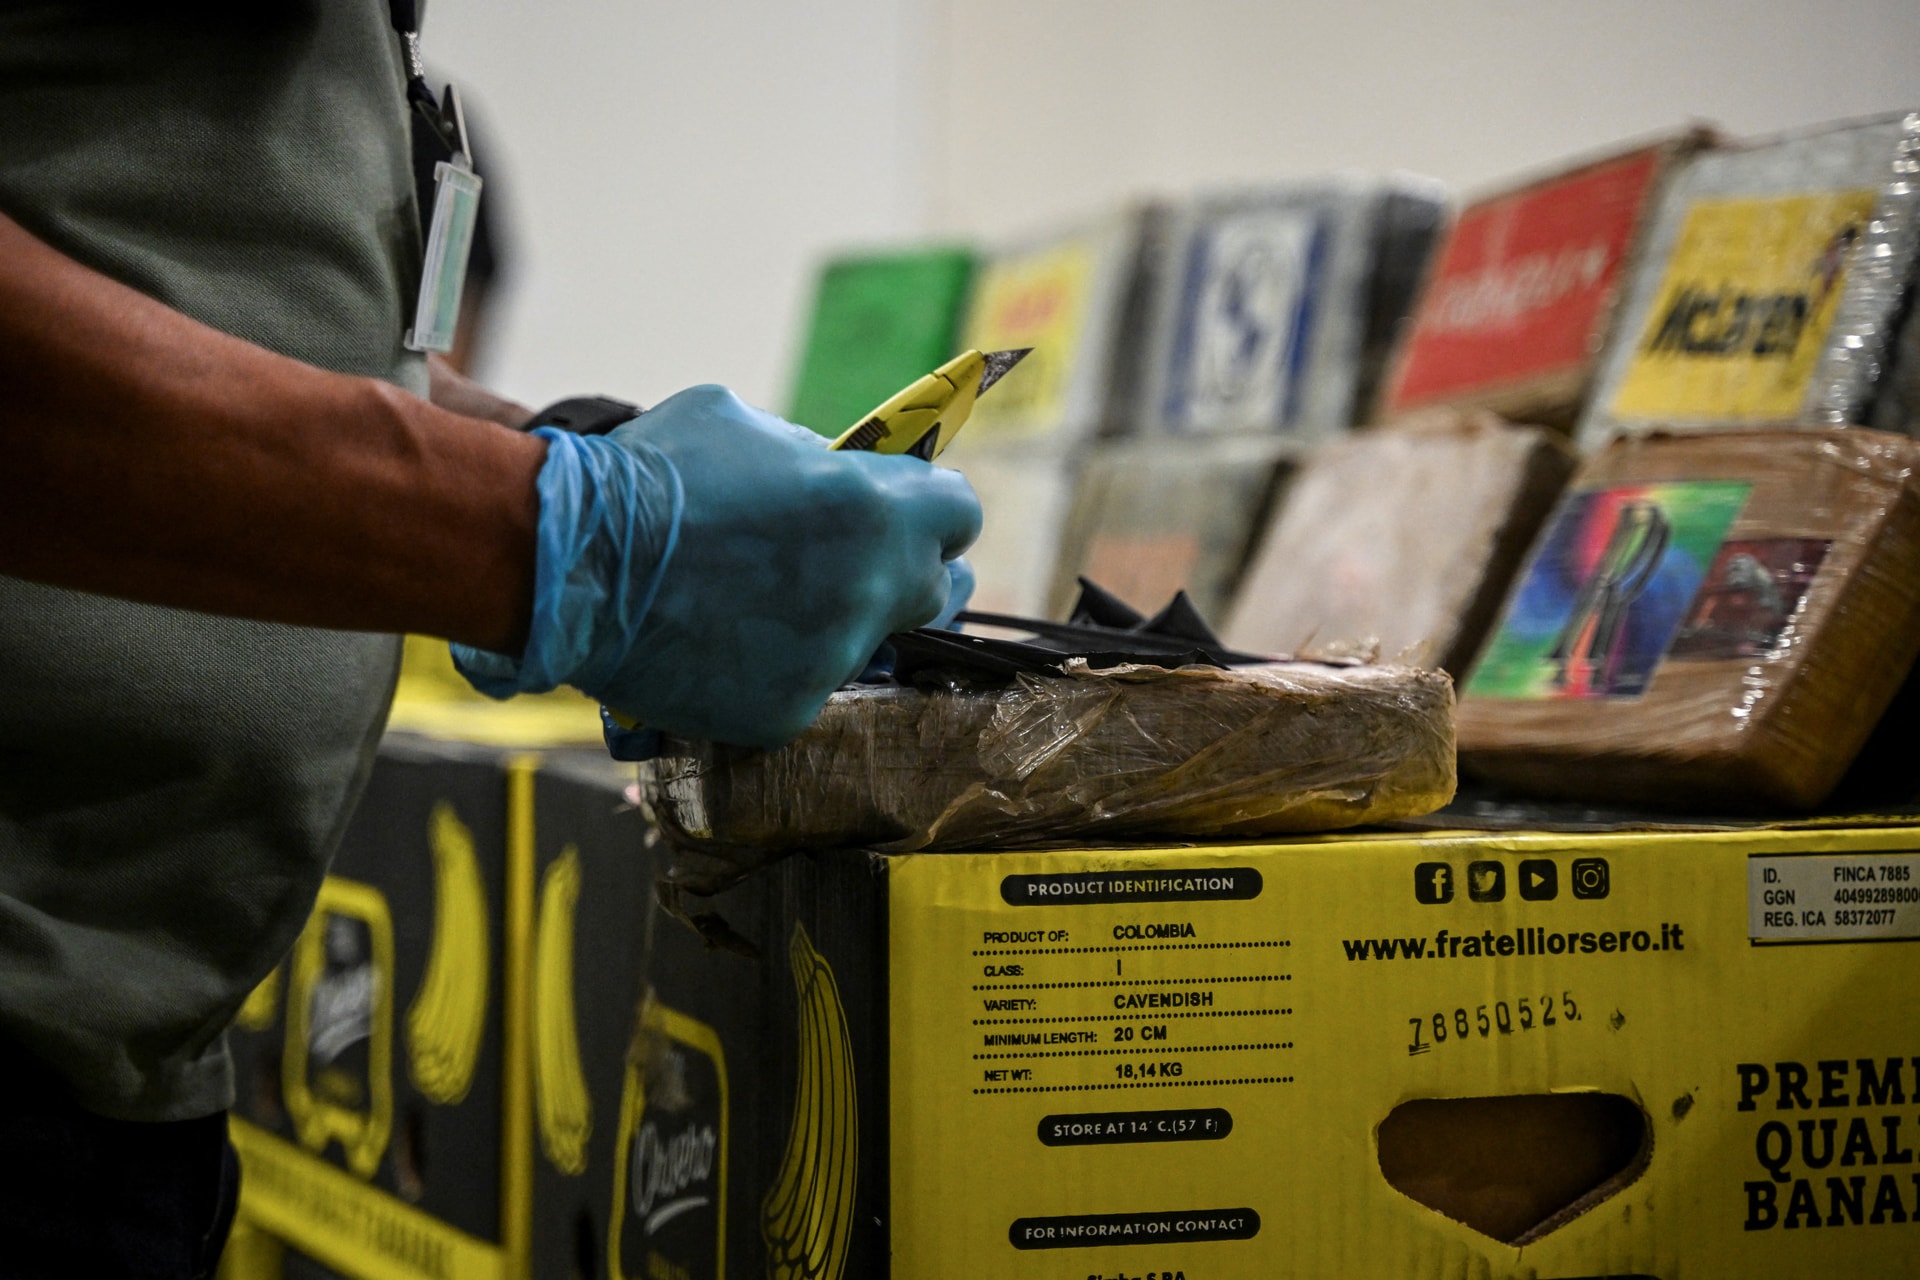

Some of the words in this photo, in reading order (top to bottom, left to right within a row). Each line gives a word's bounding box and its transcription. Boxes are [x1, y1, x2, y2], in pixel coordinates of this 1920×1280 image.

[1763, 866, 1782, 884] ID.
[1833, 866, 1876, 883] FINCA
[1879, 865, 1910, 882] 7885
[1027, 880, 1104, 897] PRODUCT
[1108, 877, 1235, 893] IDENTIFICATION
[1763, 890, 1796, 906] GGN
[1833, 887, 1920, 905] 40499289800
[1763, 911, 1799, 928] REG.
[1802, 910, 1827, 926] ICA
[1834, 909, 1897, 926] 58372077
[983, 931, 1045, 944] PRODUCT
[1048, 930, 1069, 943] OF:
[1113, 922, 1196, 940] COLOMBIA
[1343, 923, 1684, 961] www.fratelliorsero.it
[983, 965, 1025, 977] CLASS:
[983, 1000, 1037, 1012] VARIETY:
[1113, 992, 1214, 1010] CAVENDISH
[983, 1034, 1041, 1046] MINIMUM
[1043, 1032, 1098, 1045] LENGTH:
[1113, 1027, 1134, 1042] 20
[1140, 1025, 1167, 1041] CM
[983, 1070, 1008, 1082] NET
[1010, 1069, 1033, 1081] WT:
[1115, 1064, 1157, 1080] 18,14
[1159, 1062, 1183, 1077] KG
[1053, 1124, 1102, 1137] STORE
[1106, 1122, 1126, 1134] AT
[1756, 1116, 1920, 1183] QUAL
[1025, 1226, 1055, 1240] FOR
[1060, 1221, 1171, 1238] INFORMATION
[1176, 1218, 1244, 1234] CONTACT
